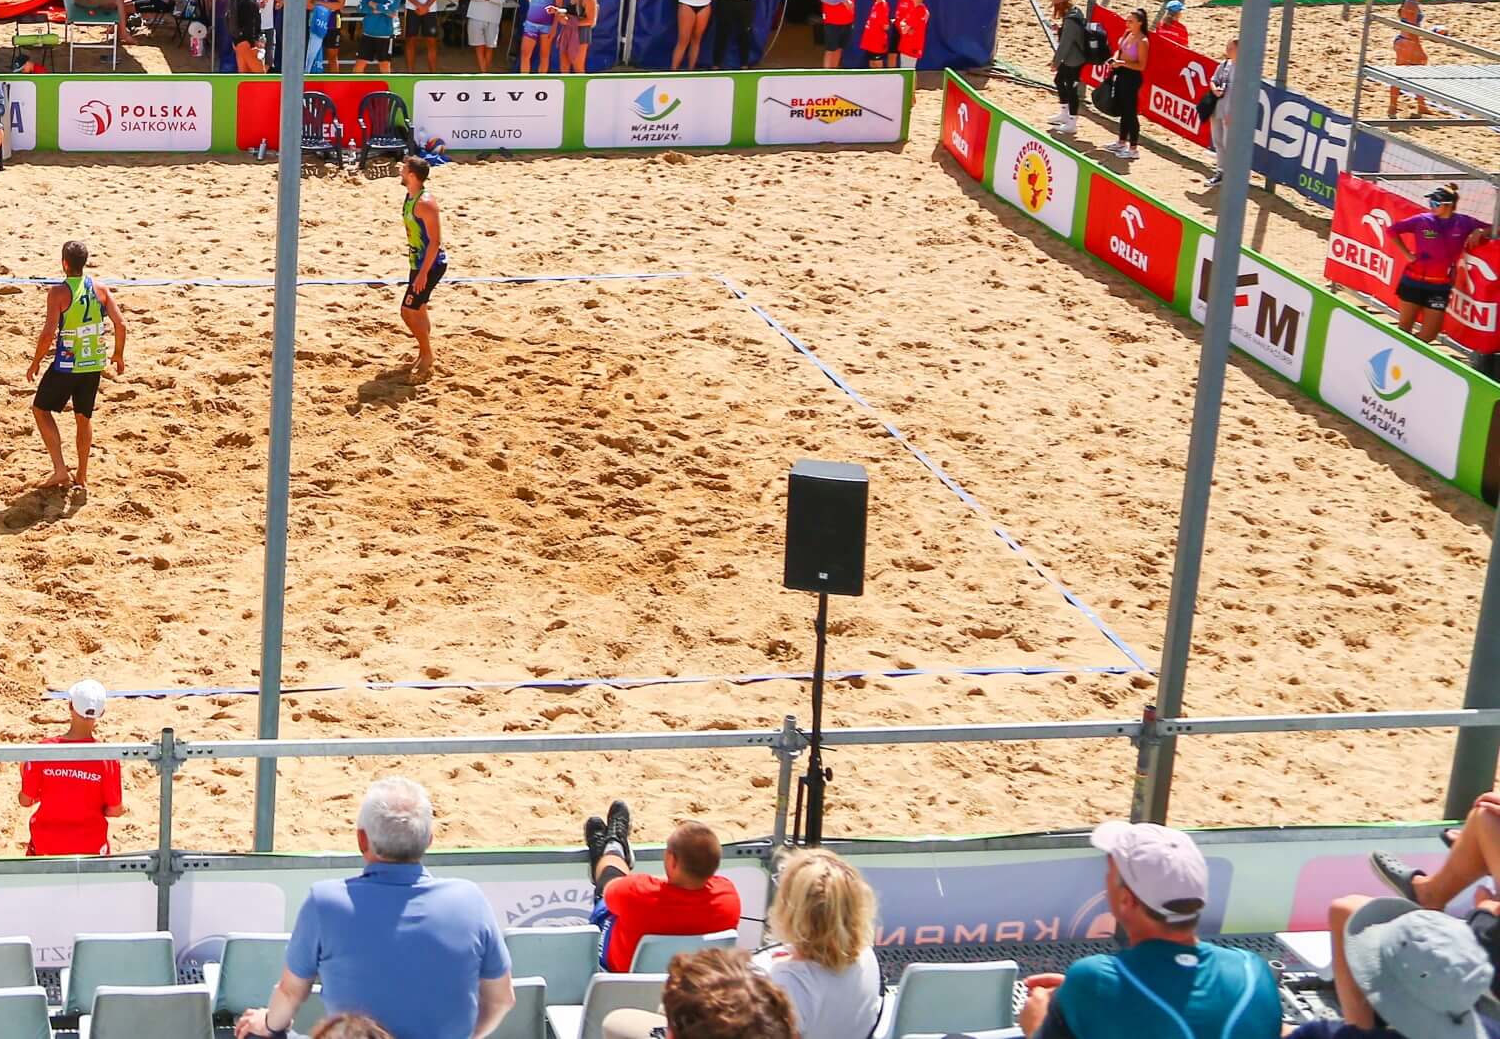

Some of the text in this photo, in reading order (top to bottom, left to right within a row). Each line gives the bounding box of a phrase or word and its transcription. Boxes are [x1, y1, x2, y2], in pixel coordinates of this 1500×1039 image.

[428, 91, 549, 102] VOLVO
[790, 98, 838, 107] BLACHY
[120, 105, 197, 118] POLSKA
[790, 106, 862, 120] PRUSZYŃSKI
[1152, 91, 1199, 128] ORLEN
[120, 118, 197, 132] SIATKÓWKA
[631, 123, 679, 132] WARMIA
[451, 129, 523, 139] NORD AUTO
[630, 132, 680, 142] MAZURY
[1109, 235, 1148, 272] ORLEN
[1331, 238, 1389, 279] ORLEN
[405, 294, 413, 305] 6
[80, 294, 92, 323] 2
[1360, 395, 1407, 427] WARMIA
[1361, 408, 1406, 442] MAZURY
